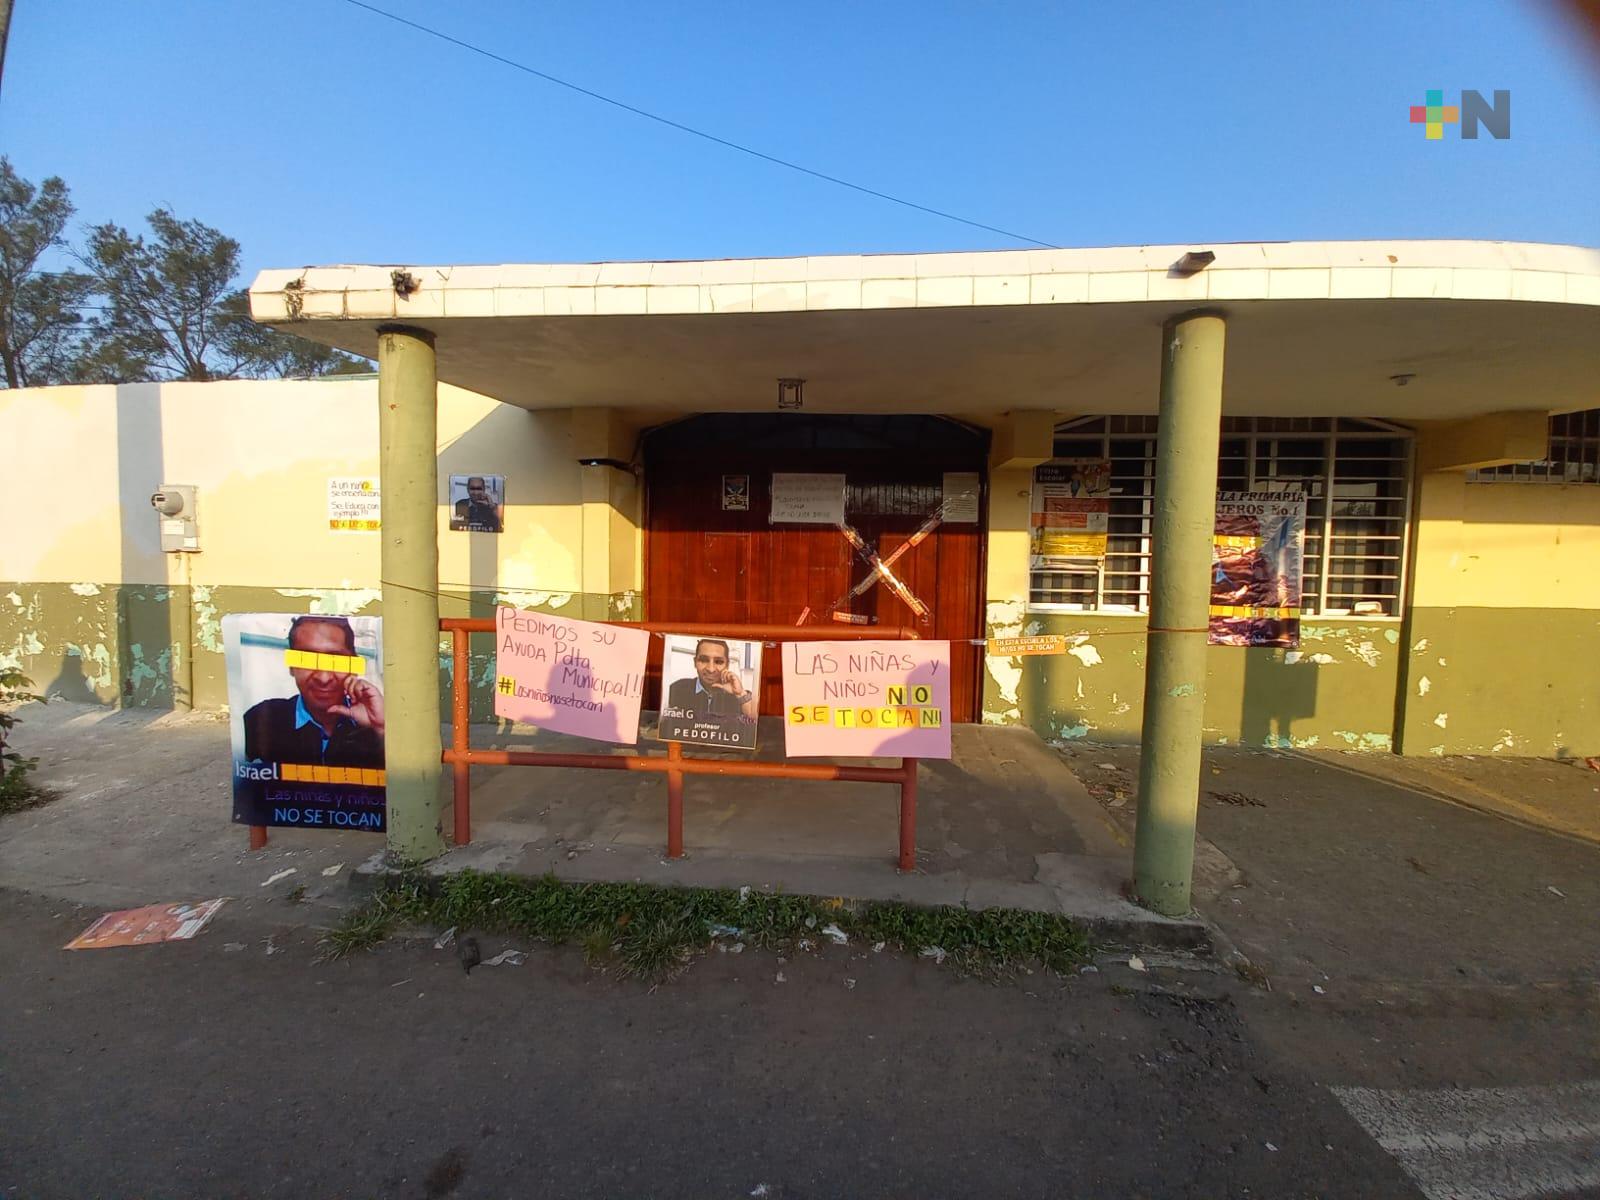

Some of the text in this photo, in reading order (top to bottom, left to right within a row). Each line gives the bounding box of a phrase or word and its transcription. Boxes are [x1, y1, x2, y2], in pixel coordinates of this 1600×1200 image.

[500, 606, 616, 645] PEDIMOS SU
[502, 634, 547, 663] AYUDA
[794, 643, 838, 675] LAS
[849, 650, 916, 673] NIÑAS
[823, 679, 929, 705] NIÑOS NO
[791, 706, 828, 723] SE
[673, 728, 740, 742] PEDOFILO
[235, 760, 279, 781] Israel
[274, 808, 381, 827] NO SE TOCAN
